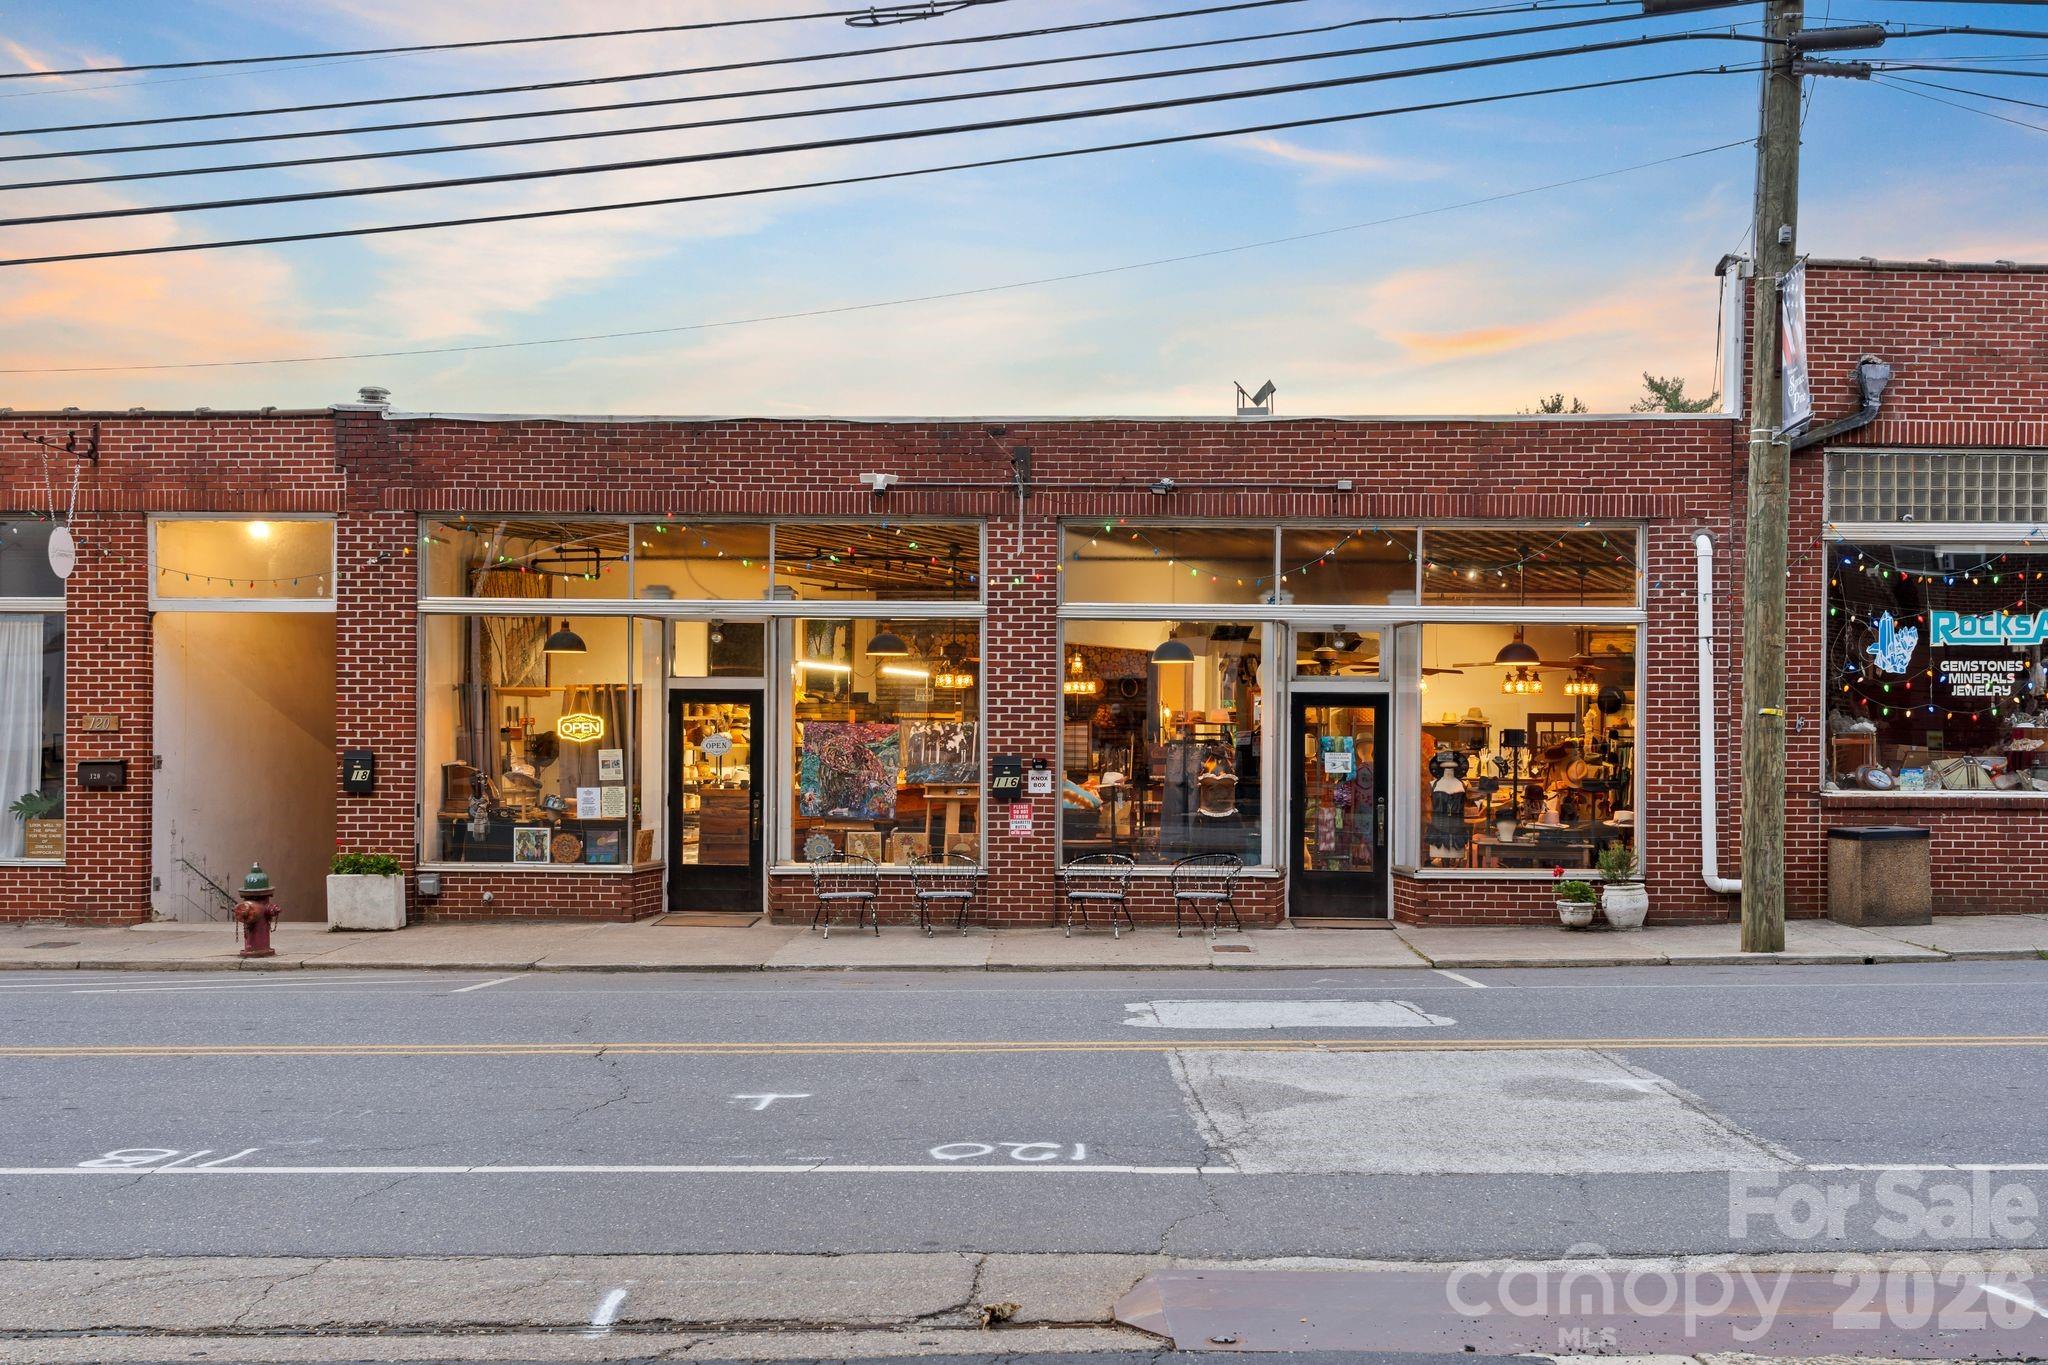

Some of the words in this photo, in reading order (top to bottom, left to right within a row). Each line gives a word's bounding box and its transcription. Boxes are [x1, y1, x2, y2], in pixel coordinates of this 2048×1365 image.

[1940, 660, 2024, 672] GEMSTONES
[1948, 673, 2016, 684] MINERALS
[1951, 685, 2012, 696] JEWELRY
[89, 717, 112, 731] 120
[561, 722, 600, 734] OPEN
[996, 778, 1017, 787] 116
